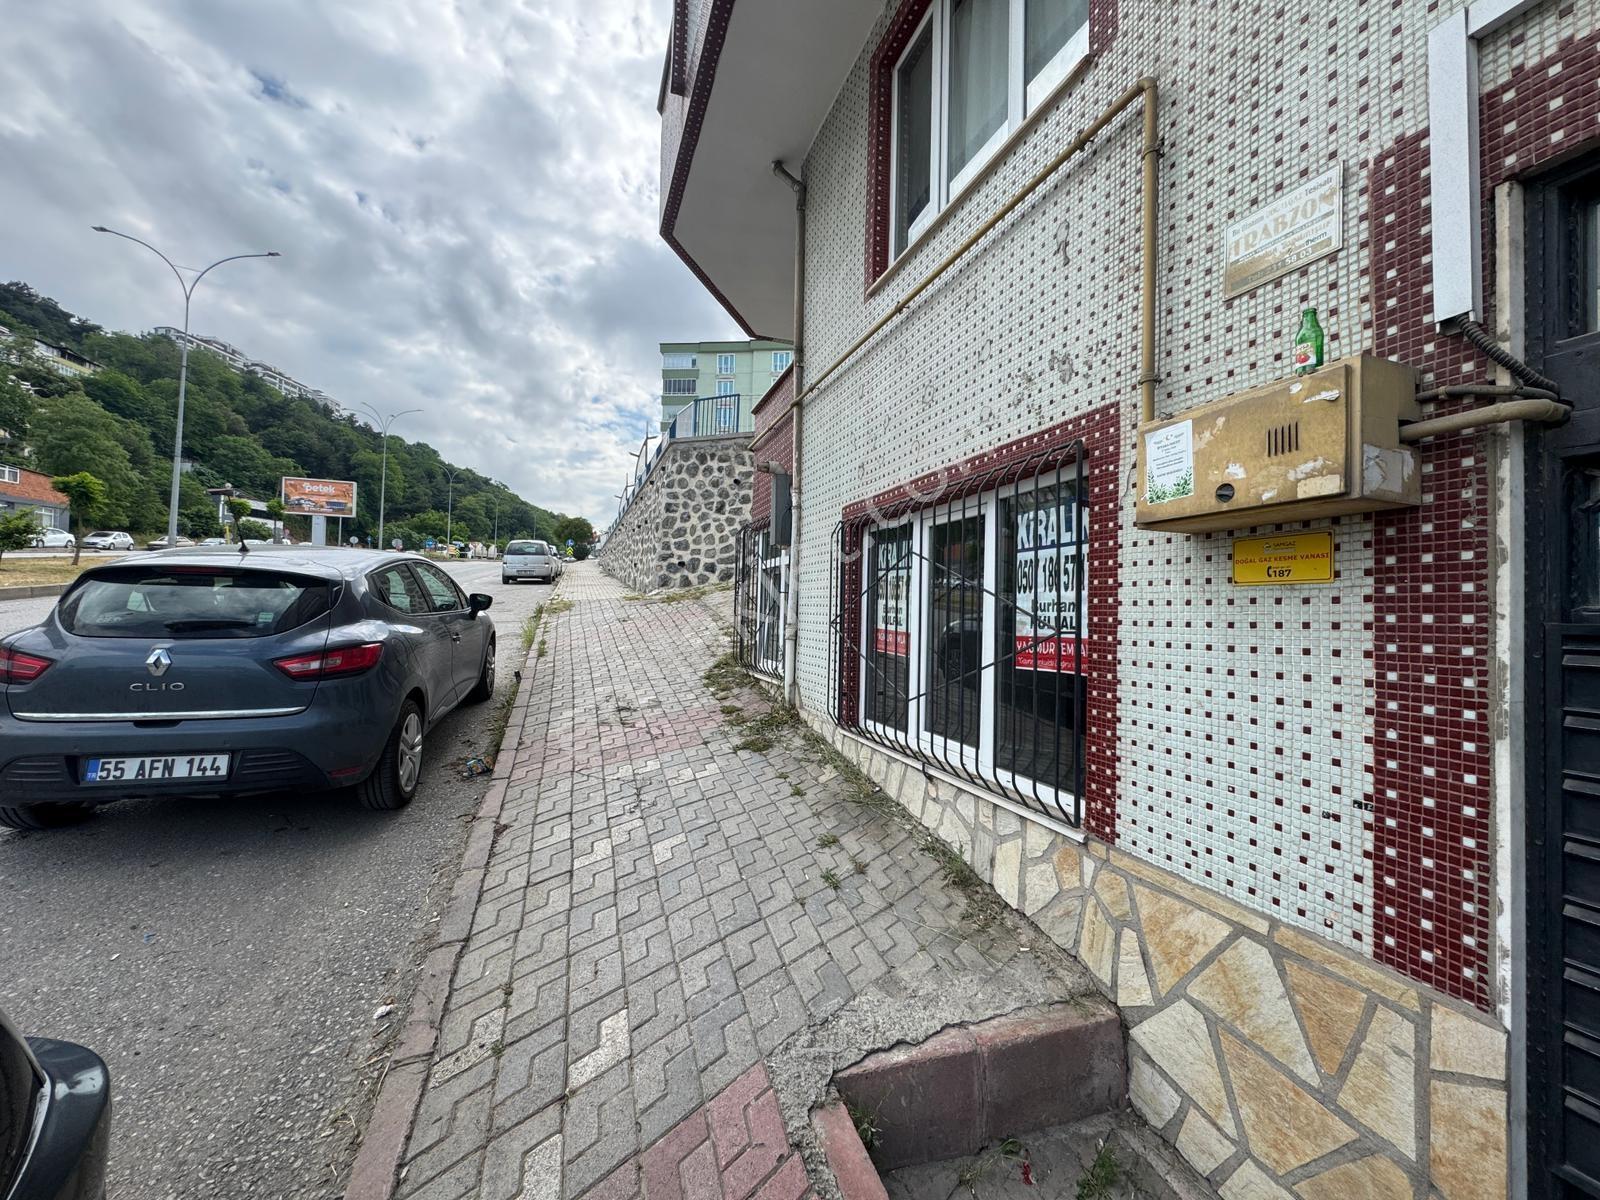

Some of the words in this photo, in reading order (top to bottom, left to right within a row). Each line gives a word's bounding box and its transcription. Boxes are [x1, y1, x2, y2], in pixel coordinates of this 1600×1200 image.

[305, 483, 336, 494] petek
[879, 539, 912, 569] KİRAIK
[1274, 554, 1297, 562] KESME
[1300, 552, 1329, 560] VANASI
[1016, 558, 1039, 594] 050
[1272, 569, 1292, 578] 187
[1031, 616, 1076, 630] ULAL
[1061, 643, 1089, 657] EMA
[129, 682, 185, 692] CLIO
[98, 759, 125, 781] 55
[135, 757, 175, 779] AFN
[186, 756, 222, 777] 144
